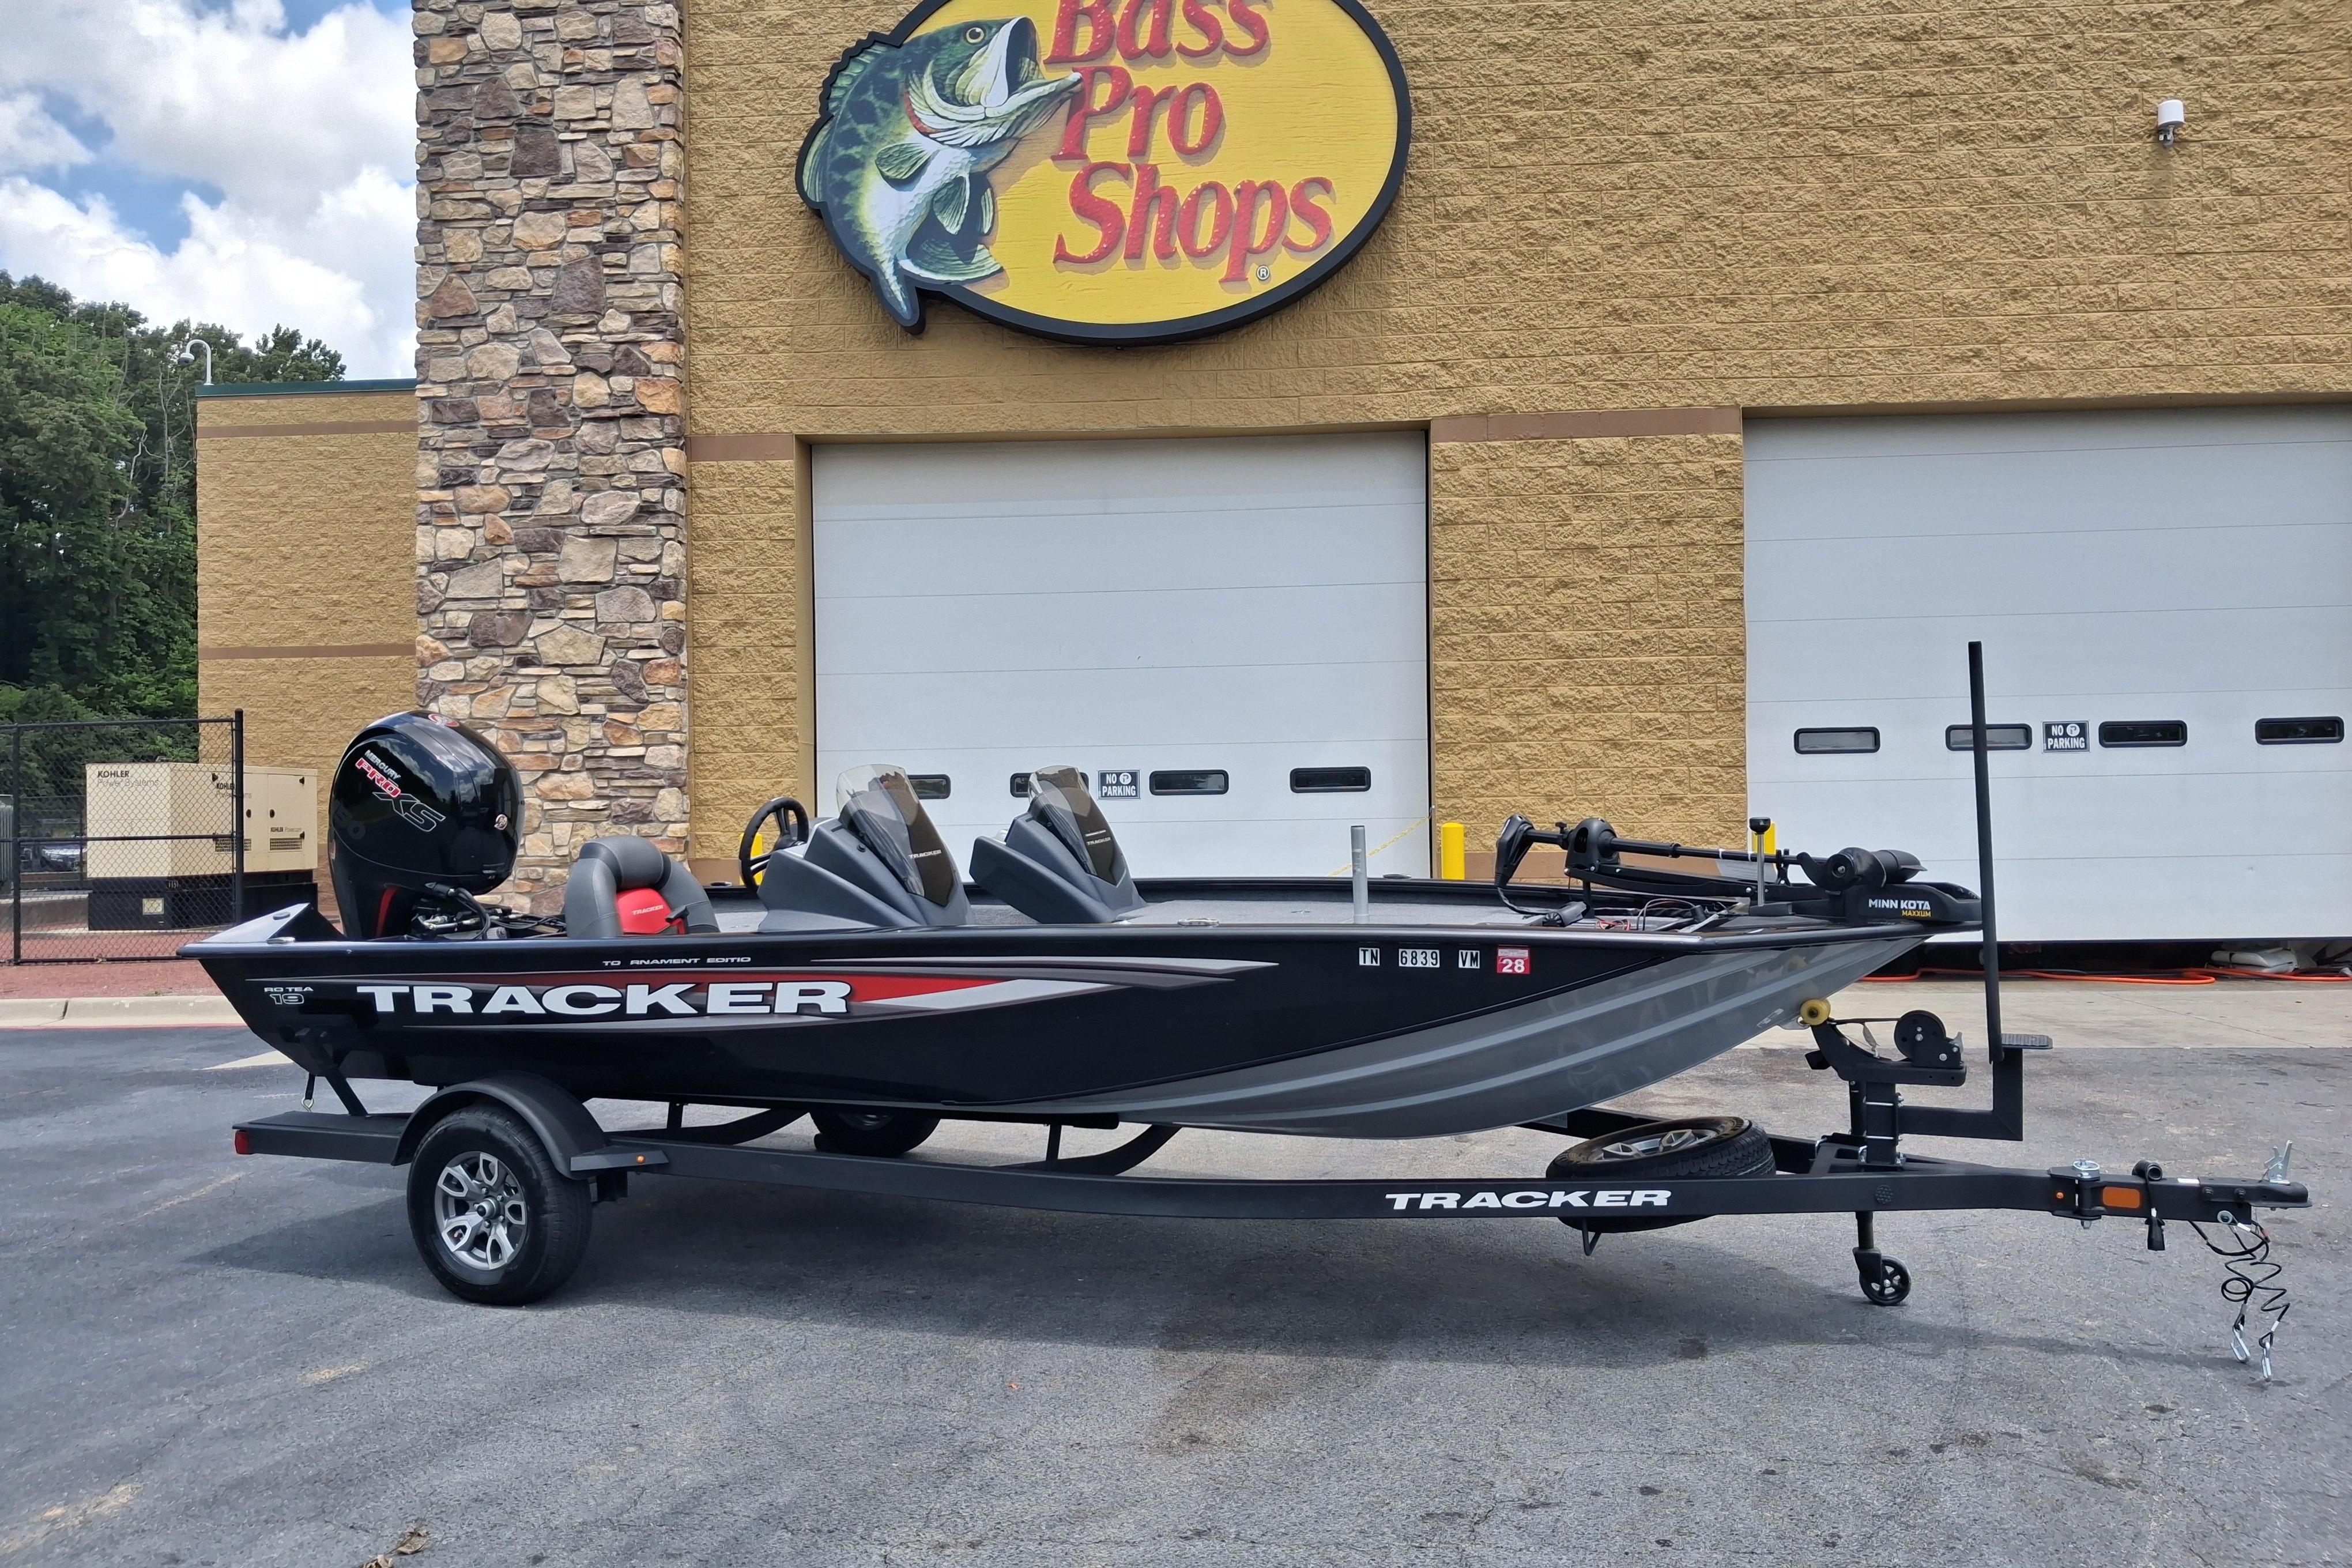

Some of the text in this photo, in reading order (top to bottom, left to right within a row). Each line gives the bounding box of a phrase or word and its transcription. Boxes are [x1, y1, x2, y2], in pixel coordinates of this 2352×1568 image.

[1043, 0, 1269, 64] Bass
[1051, 65, 1223, 160] Pro
[1053, 161, 1333, 282] Shops
[2052, 725, 2064, 736] NO
[2048, 737, 2085, 749] PARKING
[364, 749, 401, 779] MERCURY
[355, 757, 401, 797] PRO
[1106, 773, 1117, 784] NO
[1102, 785, 1136, 796] PARKING
[372, 791, 446, 832] XS
[909, 849, 941, 859] TRACKER
[1868, 899, 1931, 910] MINN KOTA
[1360, 949, 1379, 965] TN
[1400, 950, 1438, 966] 6839
[1460, 951, 1479, 968] VM
[1502, 959, 1525, 973] 28
[269, 993, 304, 1004] 19
[356, 982, 851, 1014] TRACKER
[1385, 1190, 1672, 1210] TRACKER
